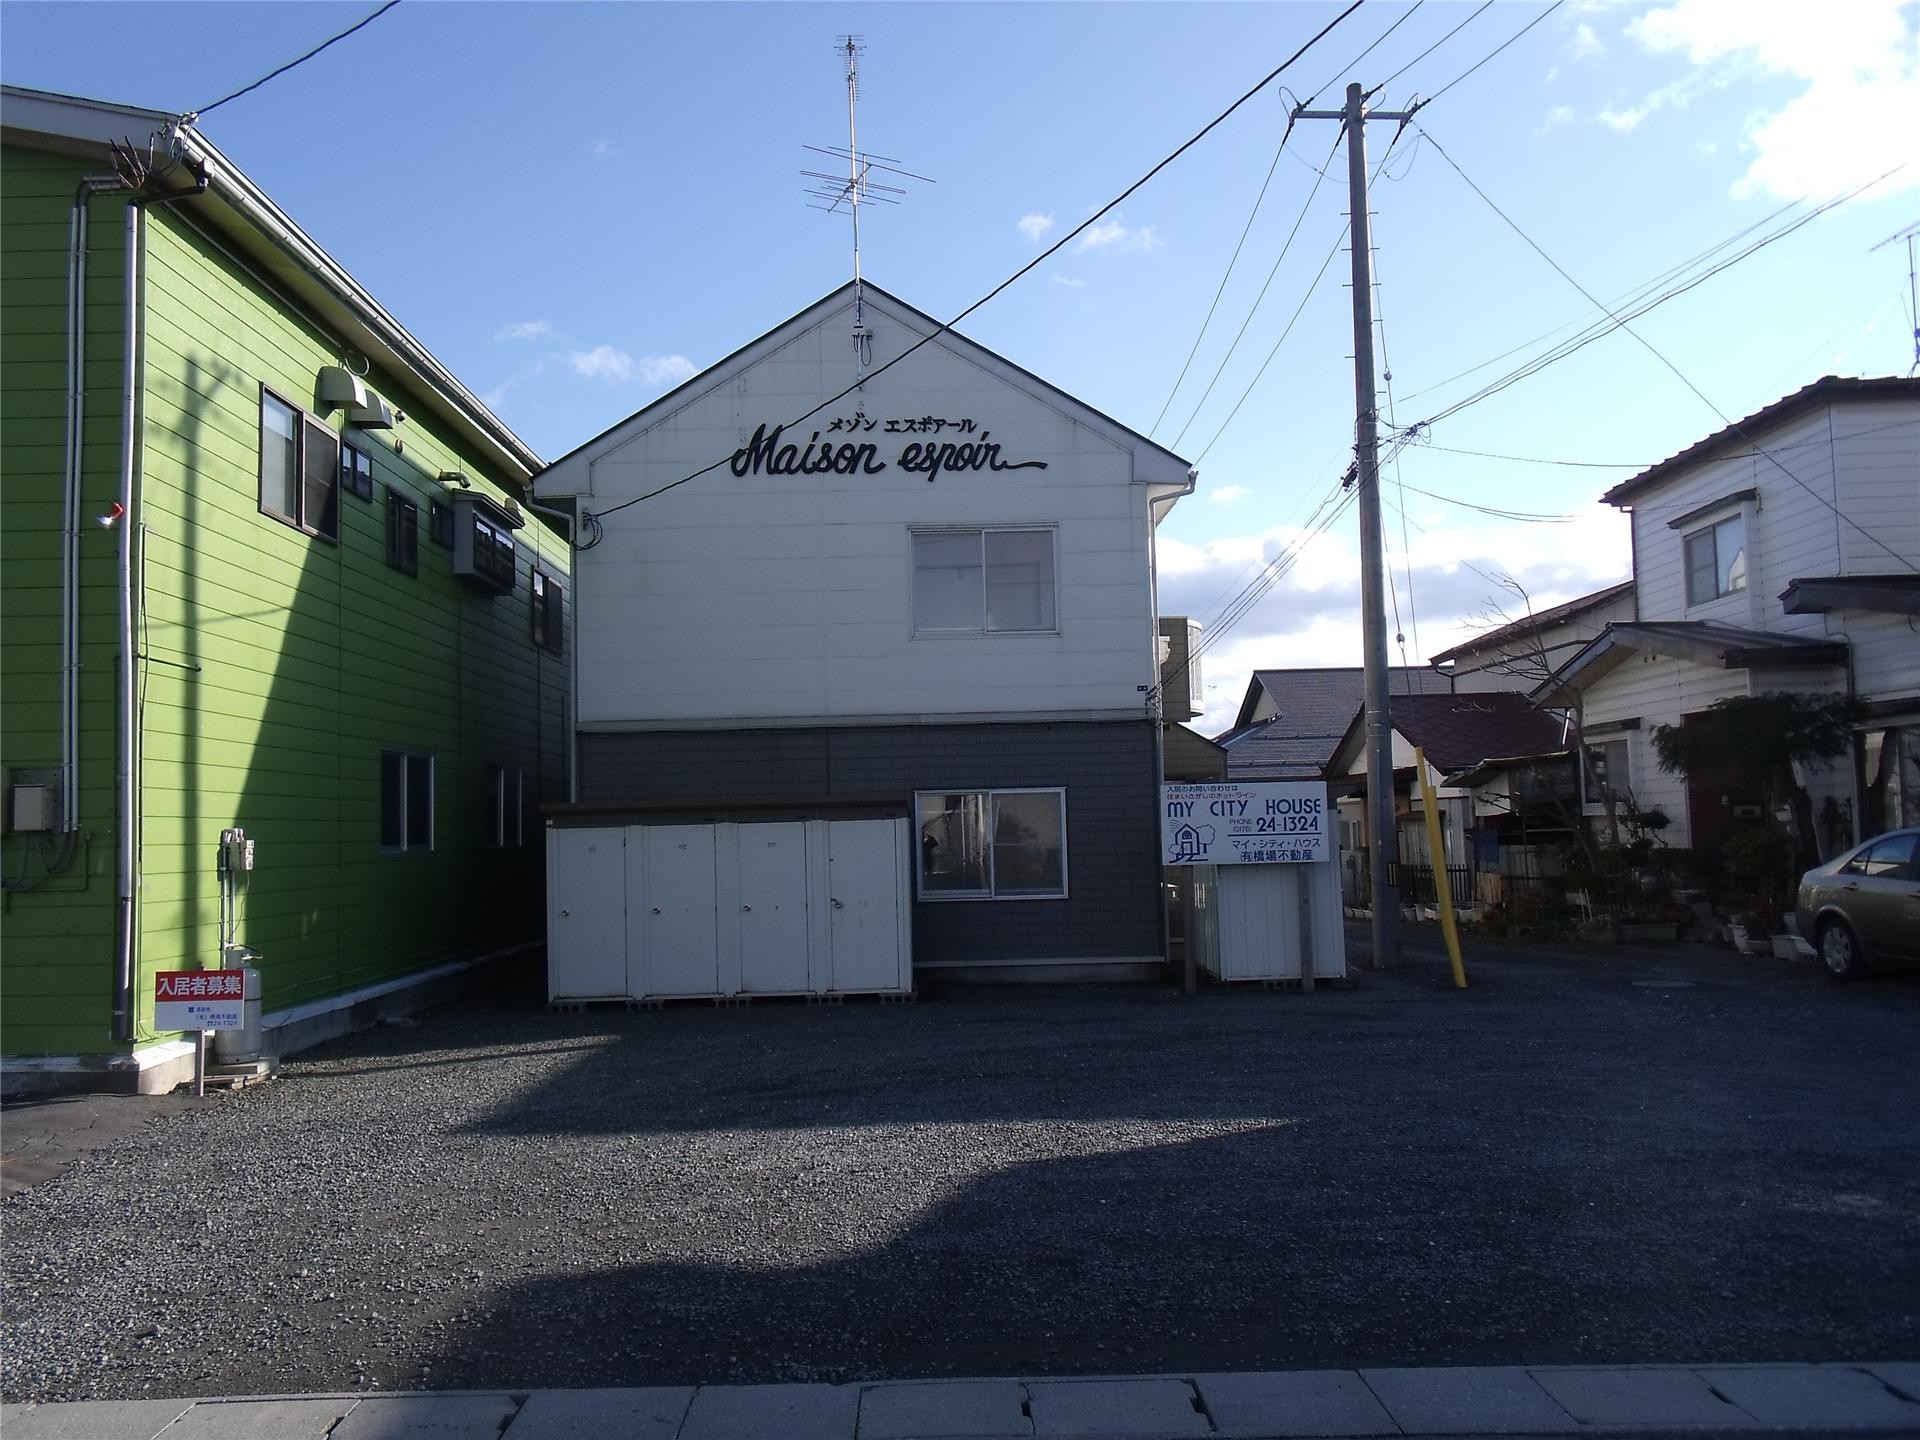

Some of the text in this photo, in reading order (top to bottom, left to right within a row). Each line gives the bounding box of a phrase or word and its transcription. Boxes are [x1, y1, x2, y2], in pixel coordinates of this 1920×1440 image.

[827, 412, 977, 434] メゾン エスポアール
[731, 423, 1047, 482] Maison espoir
[1167, 799, 1321, 817] MY CITY HOUSE
[1256, 816, 1318, 832] 24-1324
[1232, 838, 1320, 849] マイ・シティ・ハウス
[157, 976, 241, 995] 入居者募集
